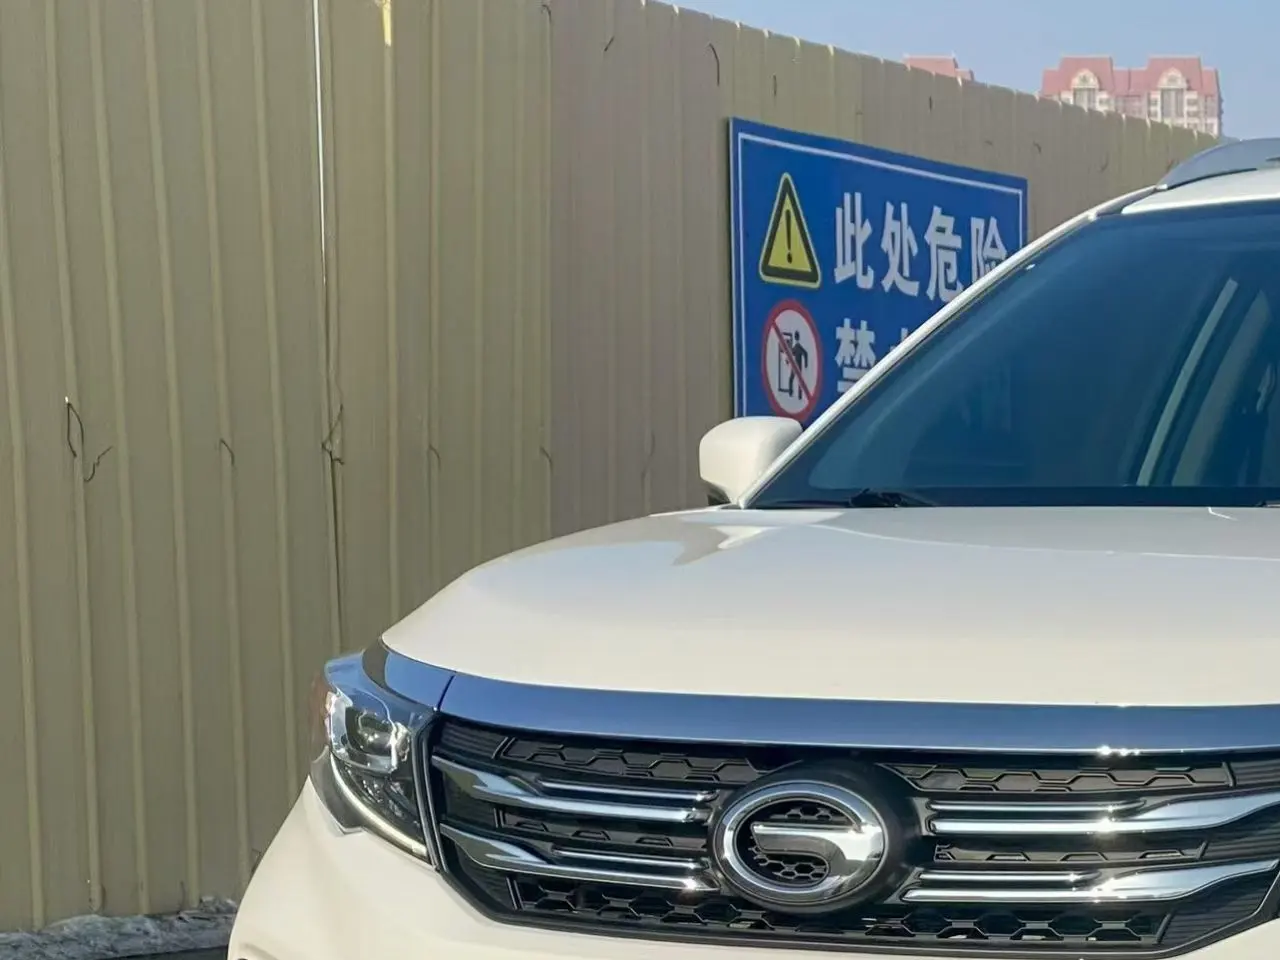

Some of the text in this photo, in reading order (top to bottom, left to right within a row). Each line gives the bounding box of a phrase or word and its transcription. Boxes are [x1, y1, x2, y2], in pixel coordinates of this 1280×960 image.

[834, 192, 1008, 301] 此处危险
[834, 317, 909, 393] 禁
